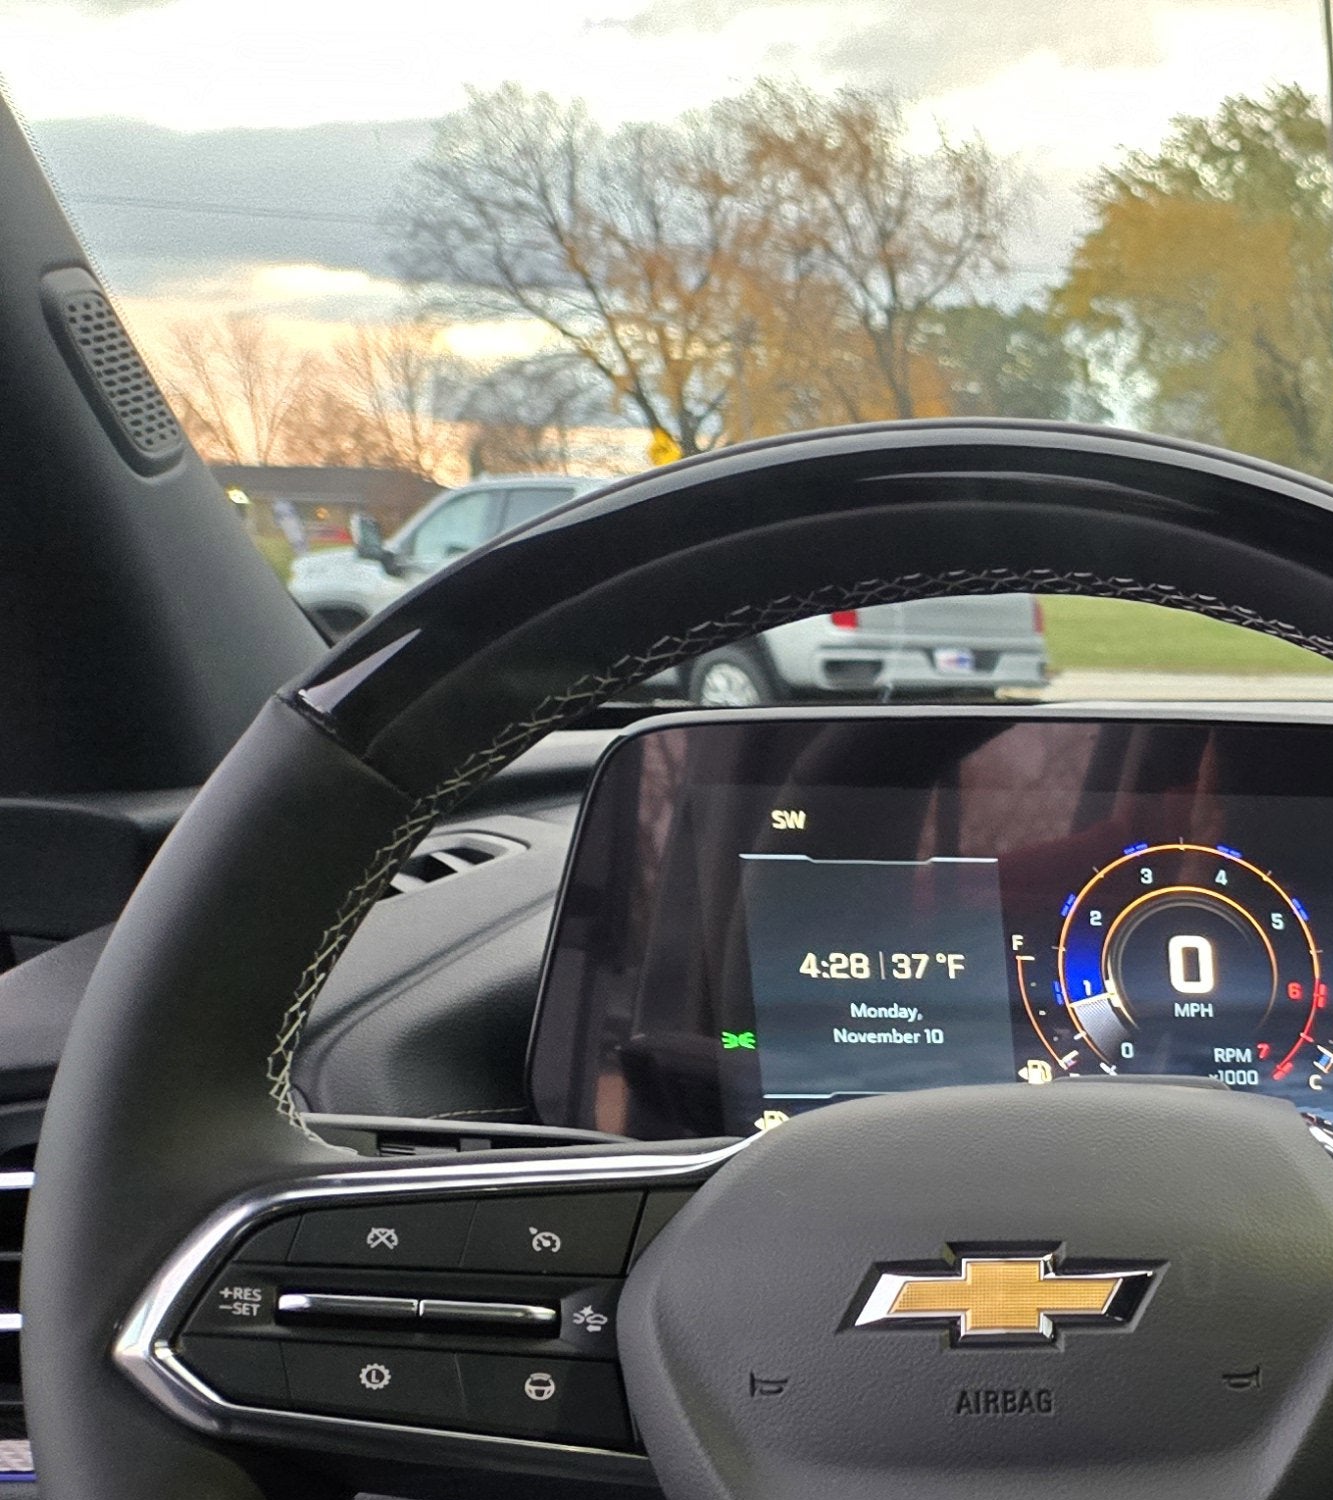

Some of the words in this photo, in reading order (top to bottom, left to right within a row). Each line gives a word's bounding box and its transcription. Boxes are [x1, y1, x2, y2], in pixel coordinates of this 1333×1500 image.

[771, 810, 806, 830] SW
[1140, 868, 1153, 884] 3
[1215, 870, 1228, 886] 4
[1089, 910, 1102, 926] 2
[1271, 913, 1285, 930] 5
[1012, 935, 1024, 951] F
[799, 952, 870, 980] 4:28
[891, 953, 929, 980] 37
[1168, 935, 1214, 993] 0
[1083, 980, 1092, 996] 1
[1287, 982, 1302, 1000] 6
[850, 1002, 923, 1021] Monday,
[1173, 1002, 1213, 1019] MPH
[833, 1028, 921, 1044] November
[925, 1029, 944, 1044] 10
[1121, 1042, 1134, 1058] 0
[1213, 1047, 1252, 1063] RPM
[1257, 1042, 1271, 1059] 7
[1308, 1073, 1323, 1091] C
[219, 1286, 262, 1302] +RES
[955, 1389, 1055, 1416] AIRBAG
